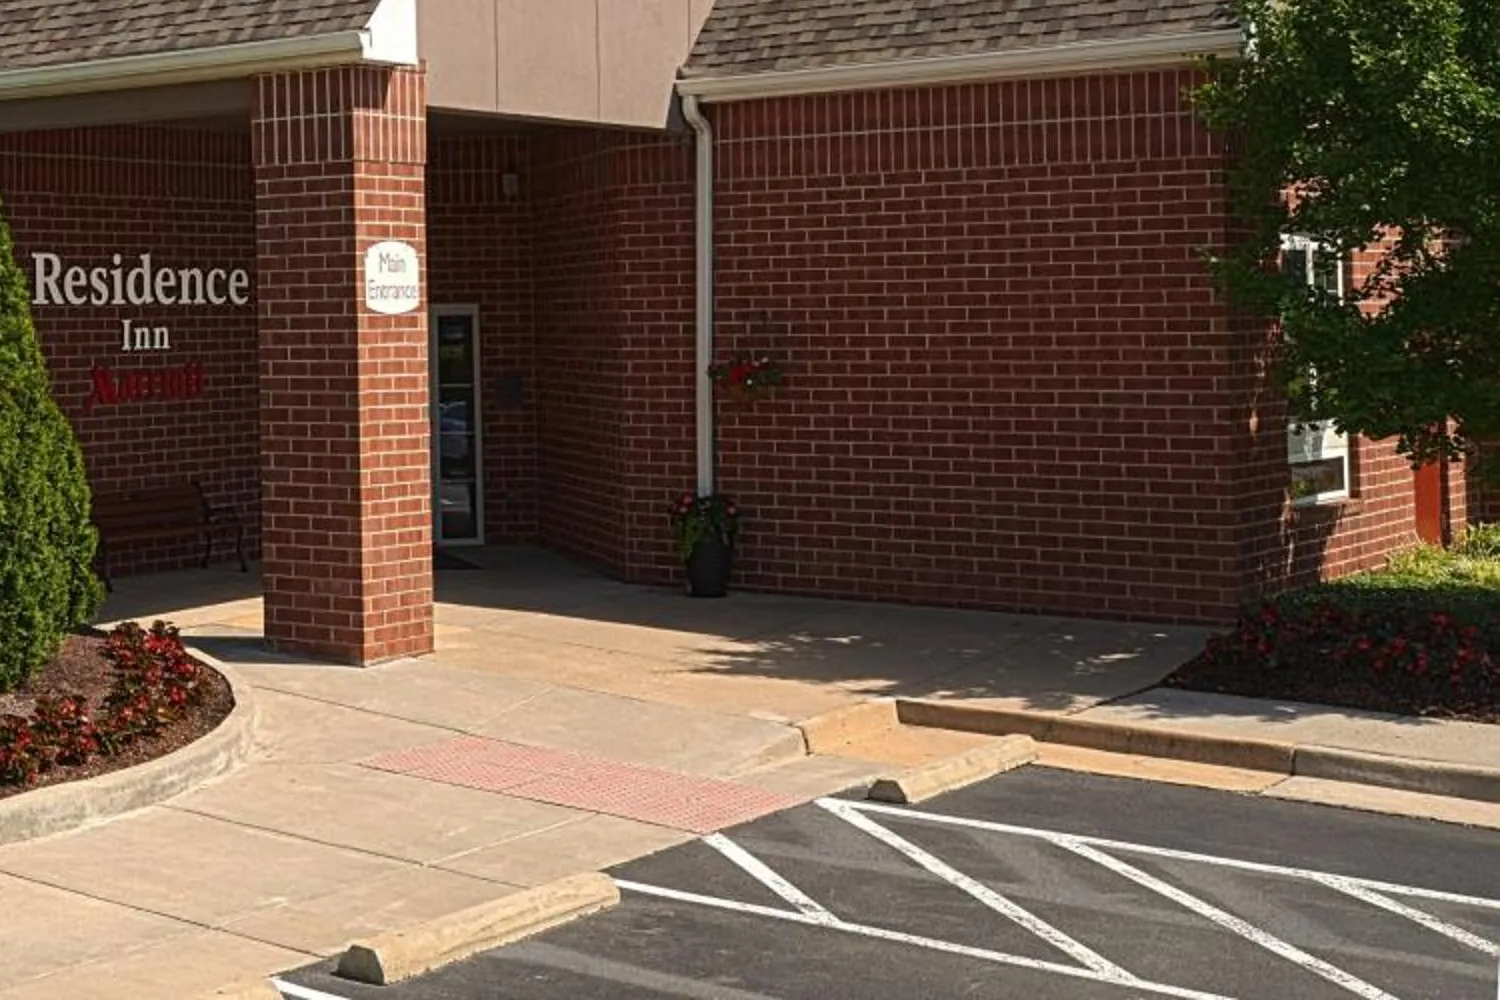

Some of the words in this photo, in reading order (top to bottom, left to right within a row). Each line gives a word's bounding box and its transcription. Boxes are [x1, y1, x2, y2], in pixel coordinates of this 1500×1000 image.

[378, 251, 406, 274] Main
[31, 252, 249, 306] Residence
[368, 278, 417, 300] Entrance
[121, 318, 172, 350] Inn
